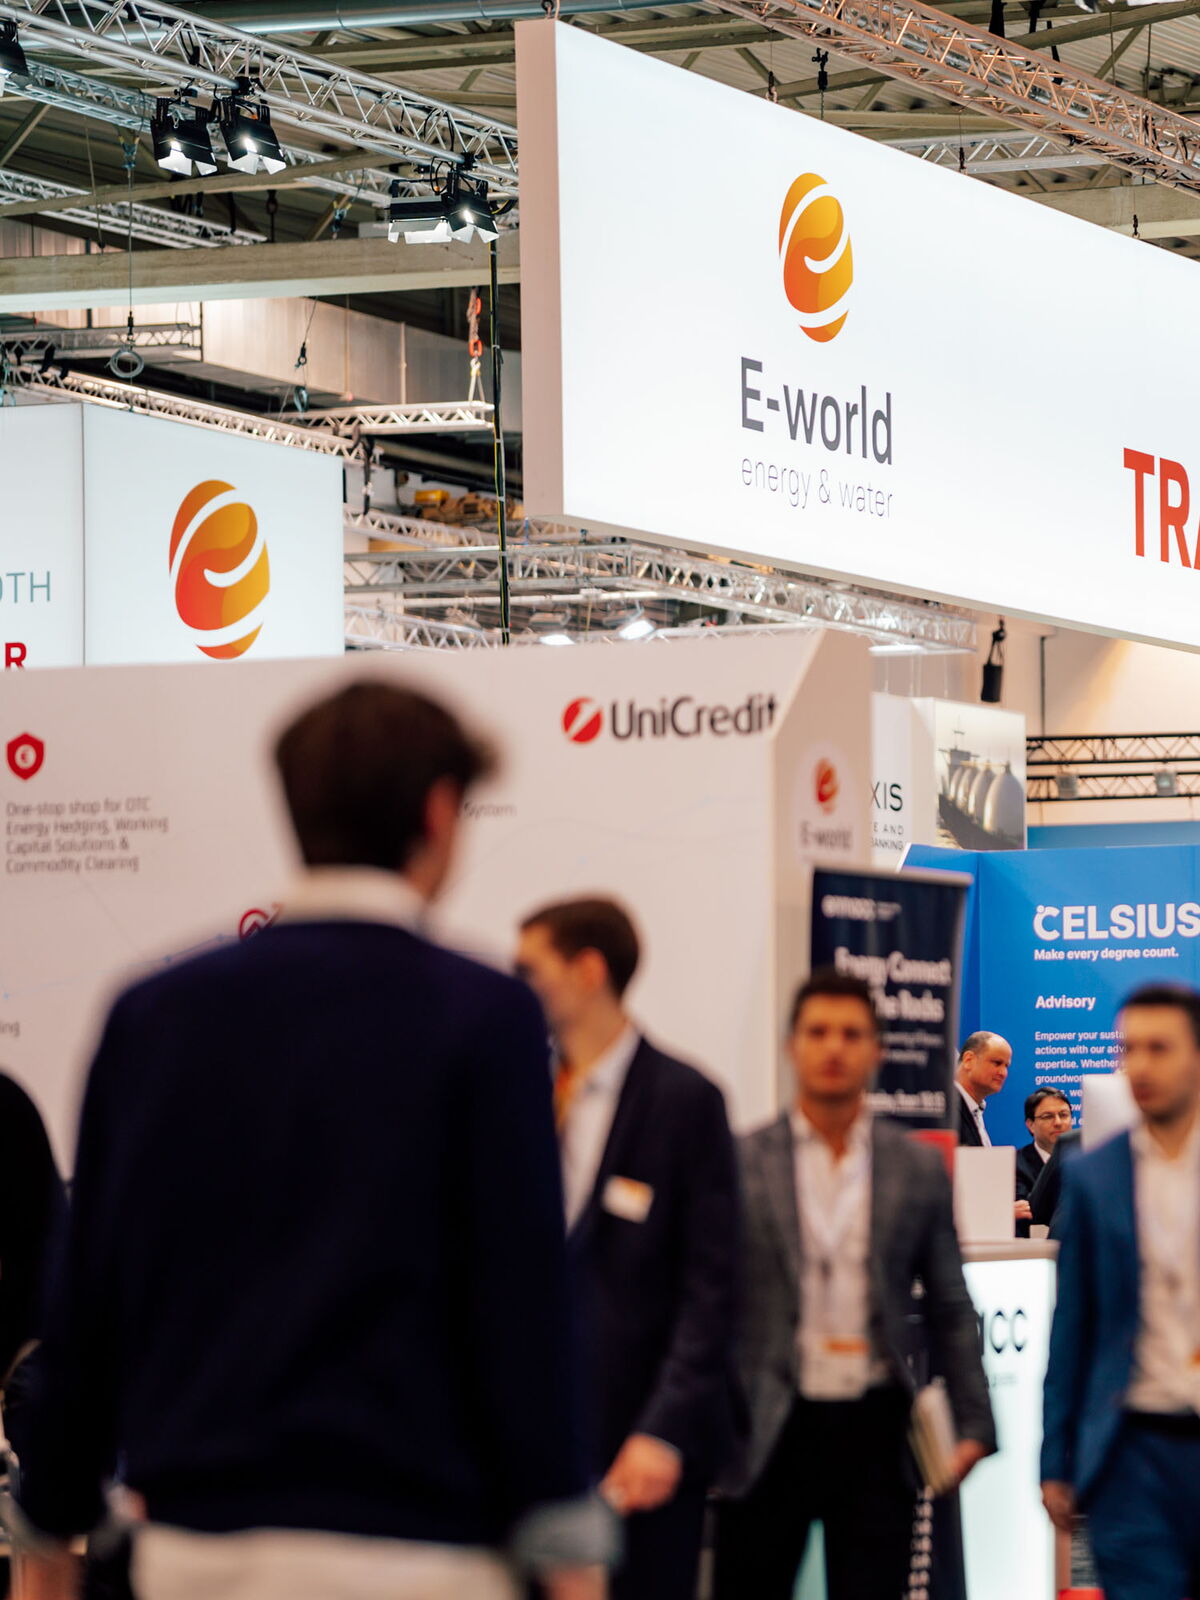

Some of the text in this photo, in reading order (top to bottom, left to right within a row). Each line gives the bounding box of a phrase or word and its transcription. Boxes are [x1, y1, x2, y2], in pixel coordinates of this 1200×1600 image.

[741, 356, 892, 465] E-world
[742, 458, 893, 518] energy & water
[0, 571, 50, 603] TH
[612, 694, 776, 740] UniCredit
[1034, 946, 1179, 962] Make every degree count.
[1035, 995, 1096, 1011] Advisory
[1034, 1031, 1076, 1042] Empower
[1078, 1032, 1098, 1042] your
[1035, 1046, 1067, 1055] actions
[1069, 1045, 1088, 1054] with
[1035, 1059, 1119, 1070] expertise. Whether
